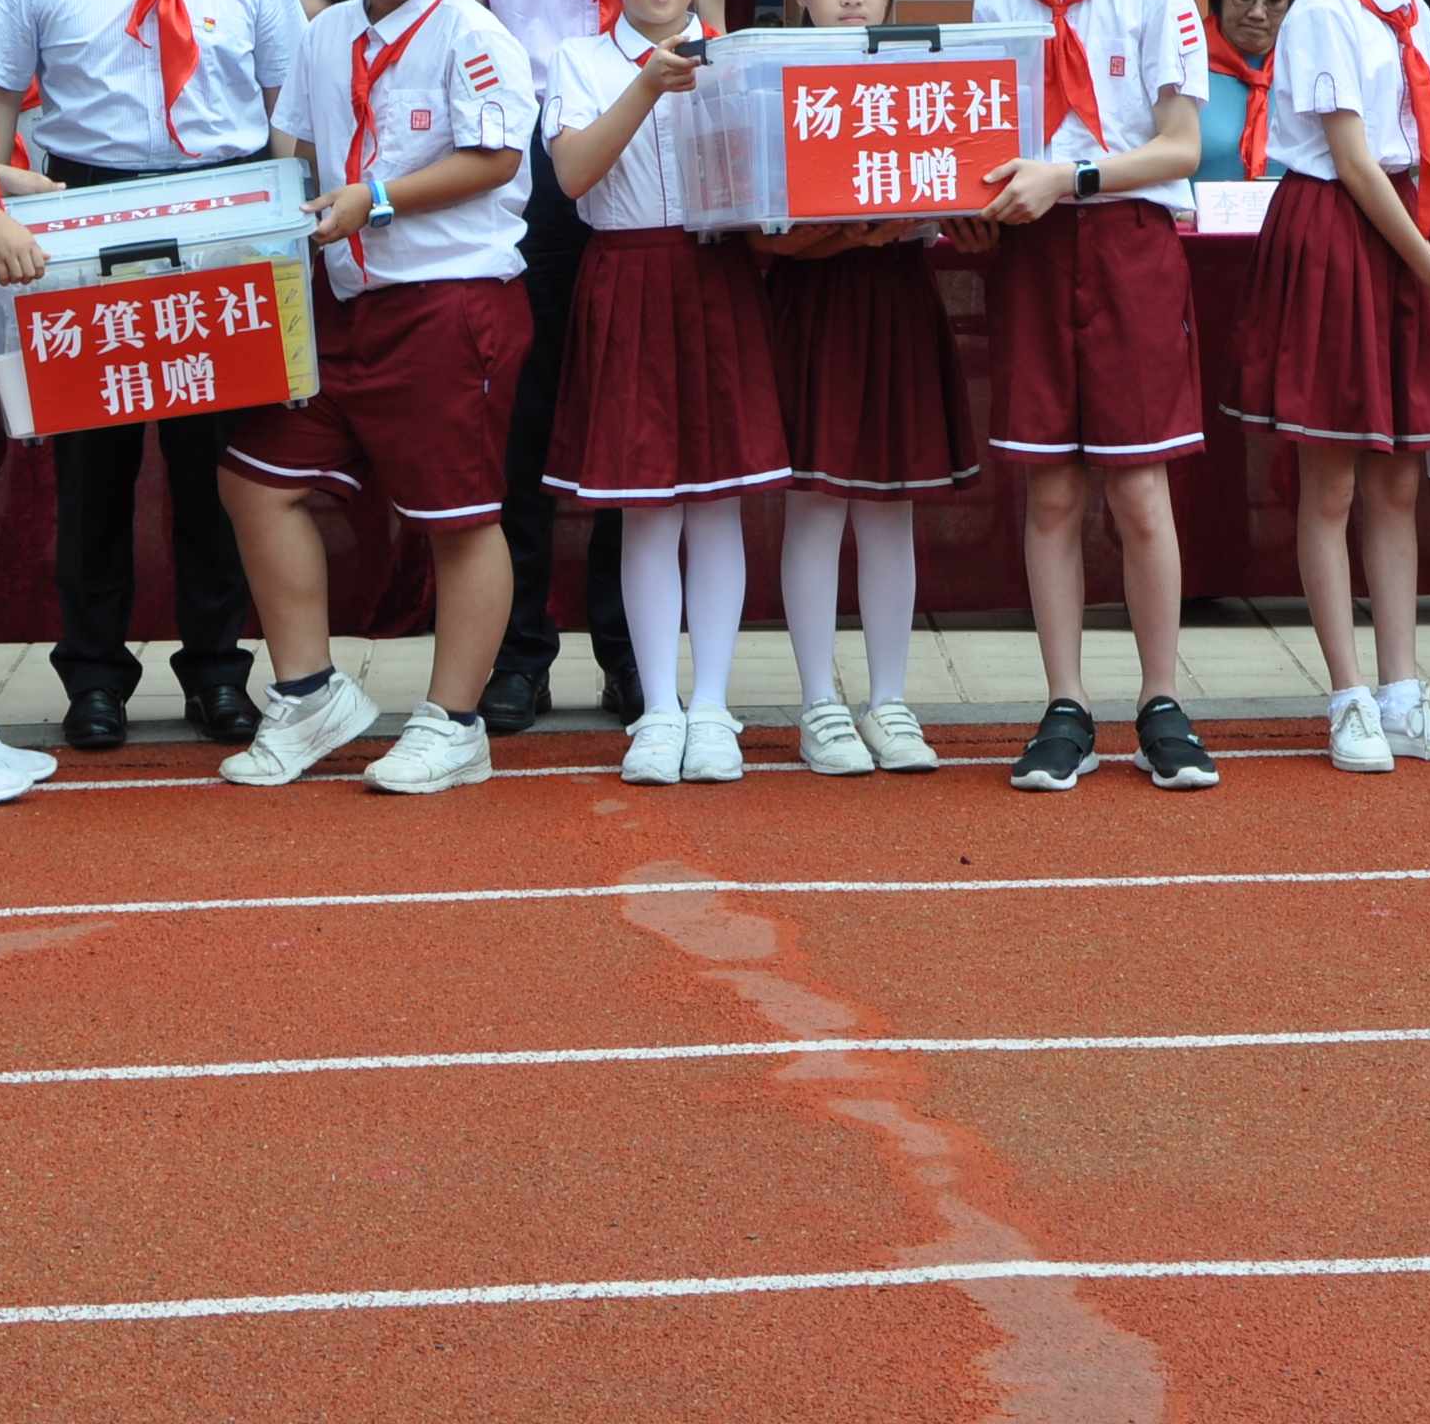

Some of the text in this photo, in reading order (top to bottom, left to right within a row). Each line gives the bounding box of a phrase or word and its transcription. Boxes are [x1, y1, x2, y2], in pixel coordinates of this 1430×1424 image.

[792, 79, 1013, 142] 杨箕联社
[852, 146, 959, 206] 捐赠
[29, 281, 273, 364] 杨箕联社
[100, 352, 217, 416] 捐赠
